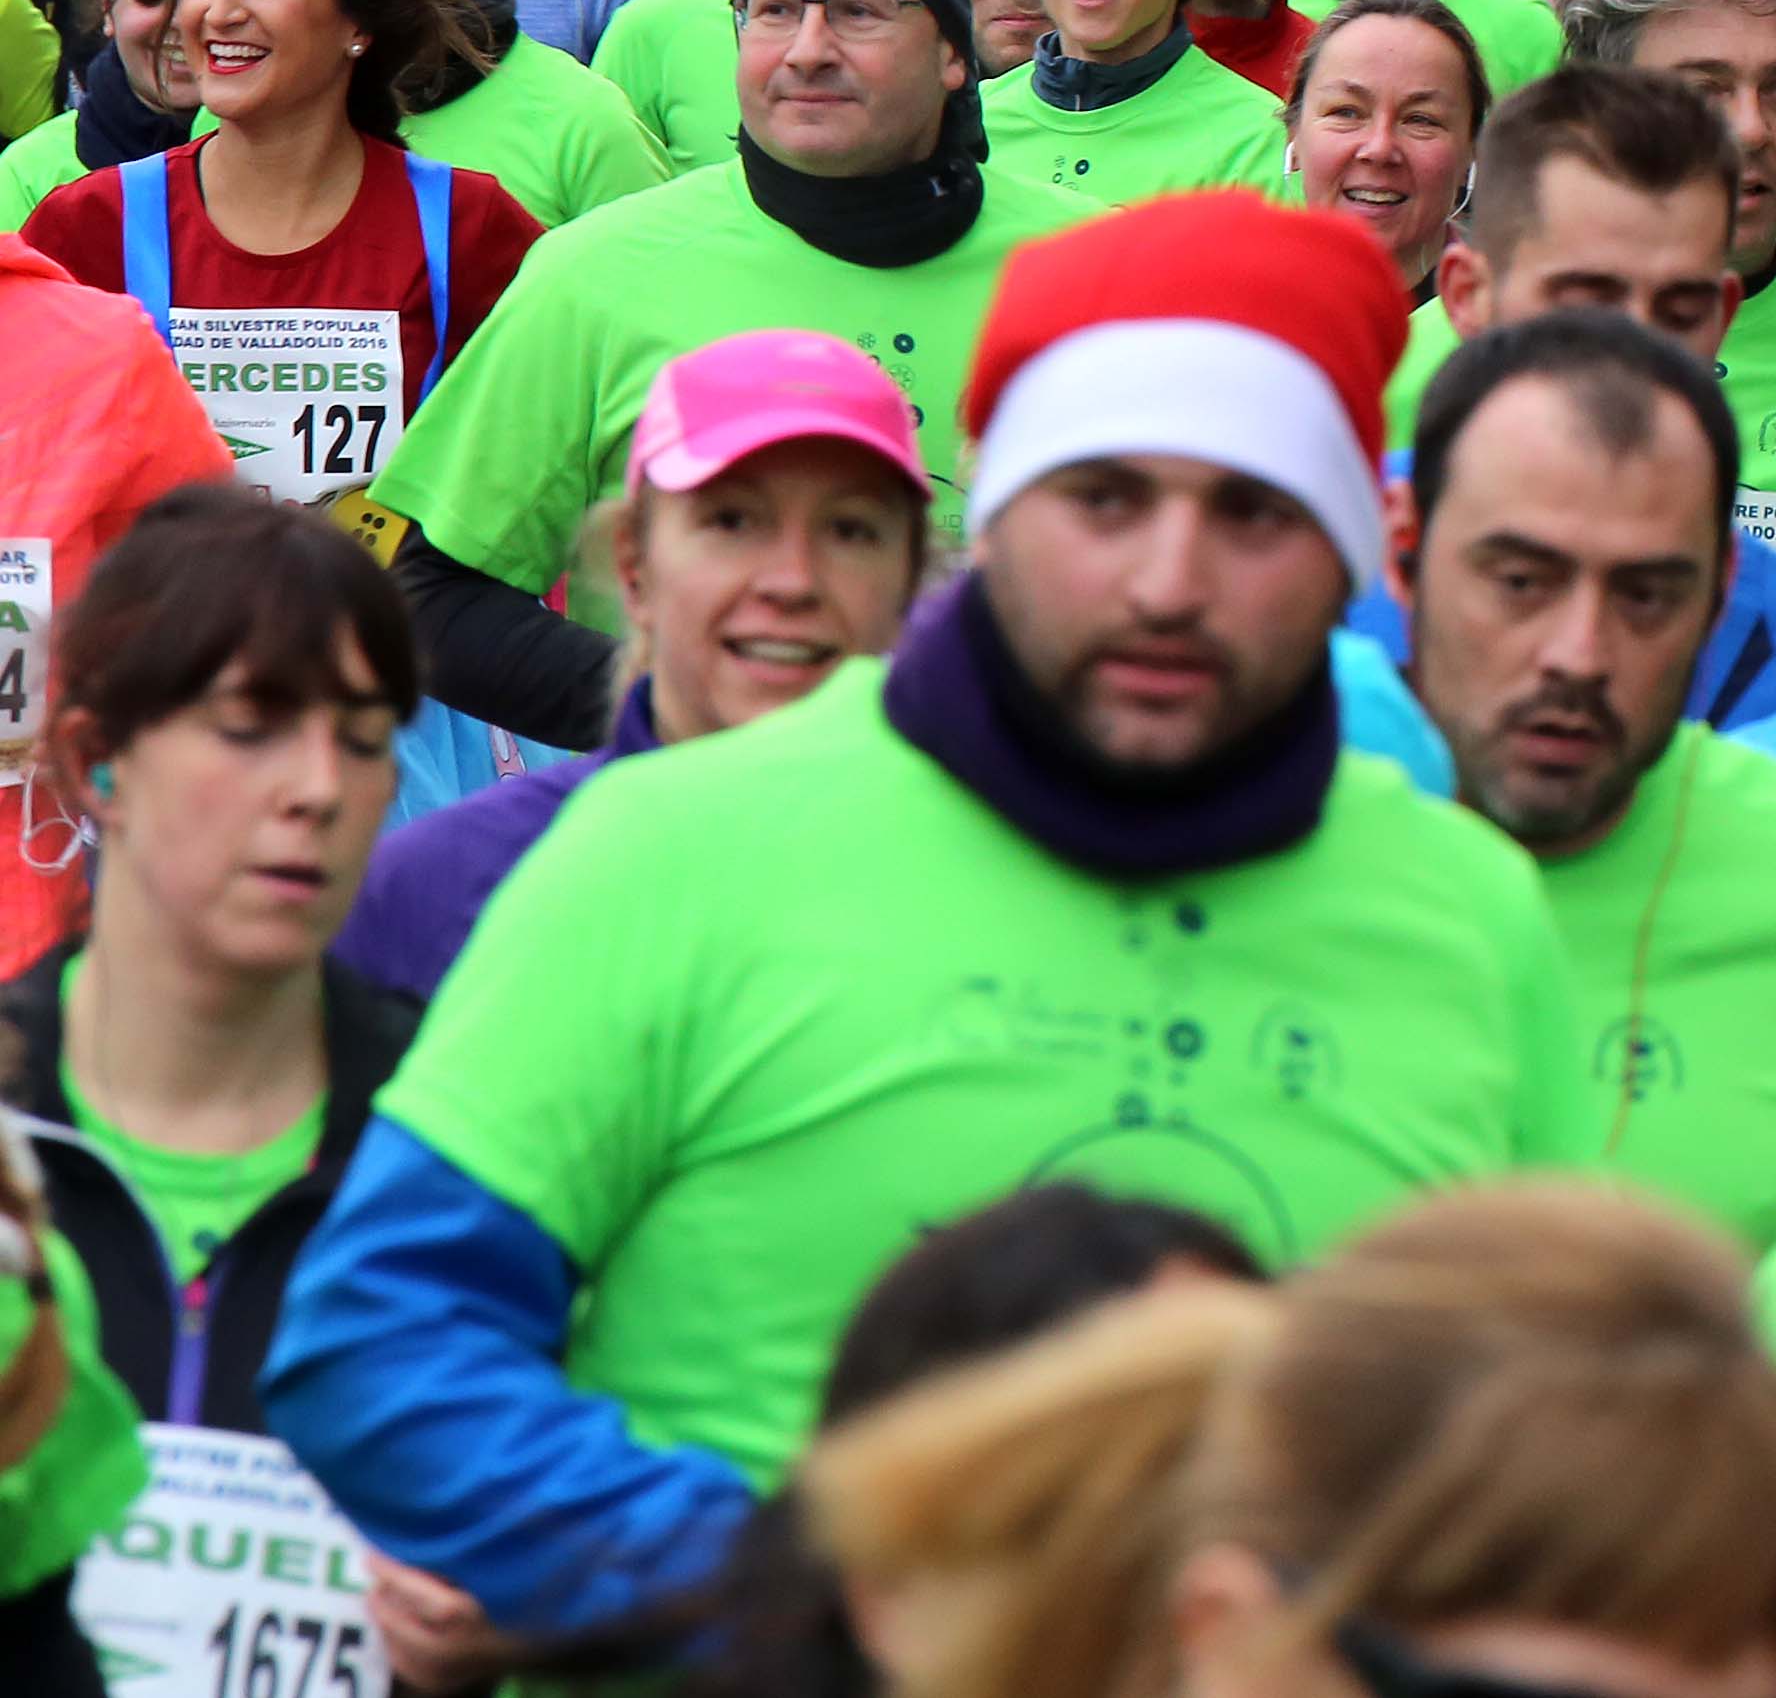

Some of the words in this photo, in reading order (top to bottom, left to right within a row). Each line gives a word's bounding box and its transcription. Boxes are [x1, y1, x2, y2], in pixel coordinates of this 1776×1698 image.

[204, 319, 297, 333] SILVESTRE
[303, 319, 380, 334] POPULAR
[211, 336, 233, 350] DE
[238, 337, 344, 350] VALLADOLID
[349, 337, 389, 350] 2016
[292, 403, 387, 474] 127
[0, 648, 28, 723] 4
[208, 1601, 364, 1698] 1675
